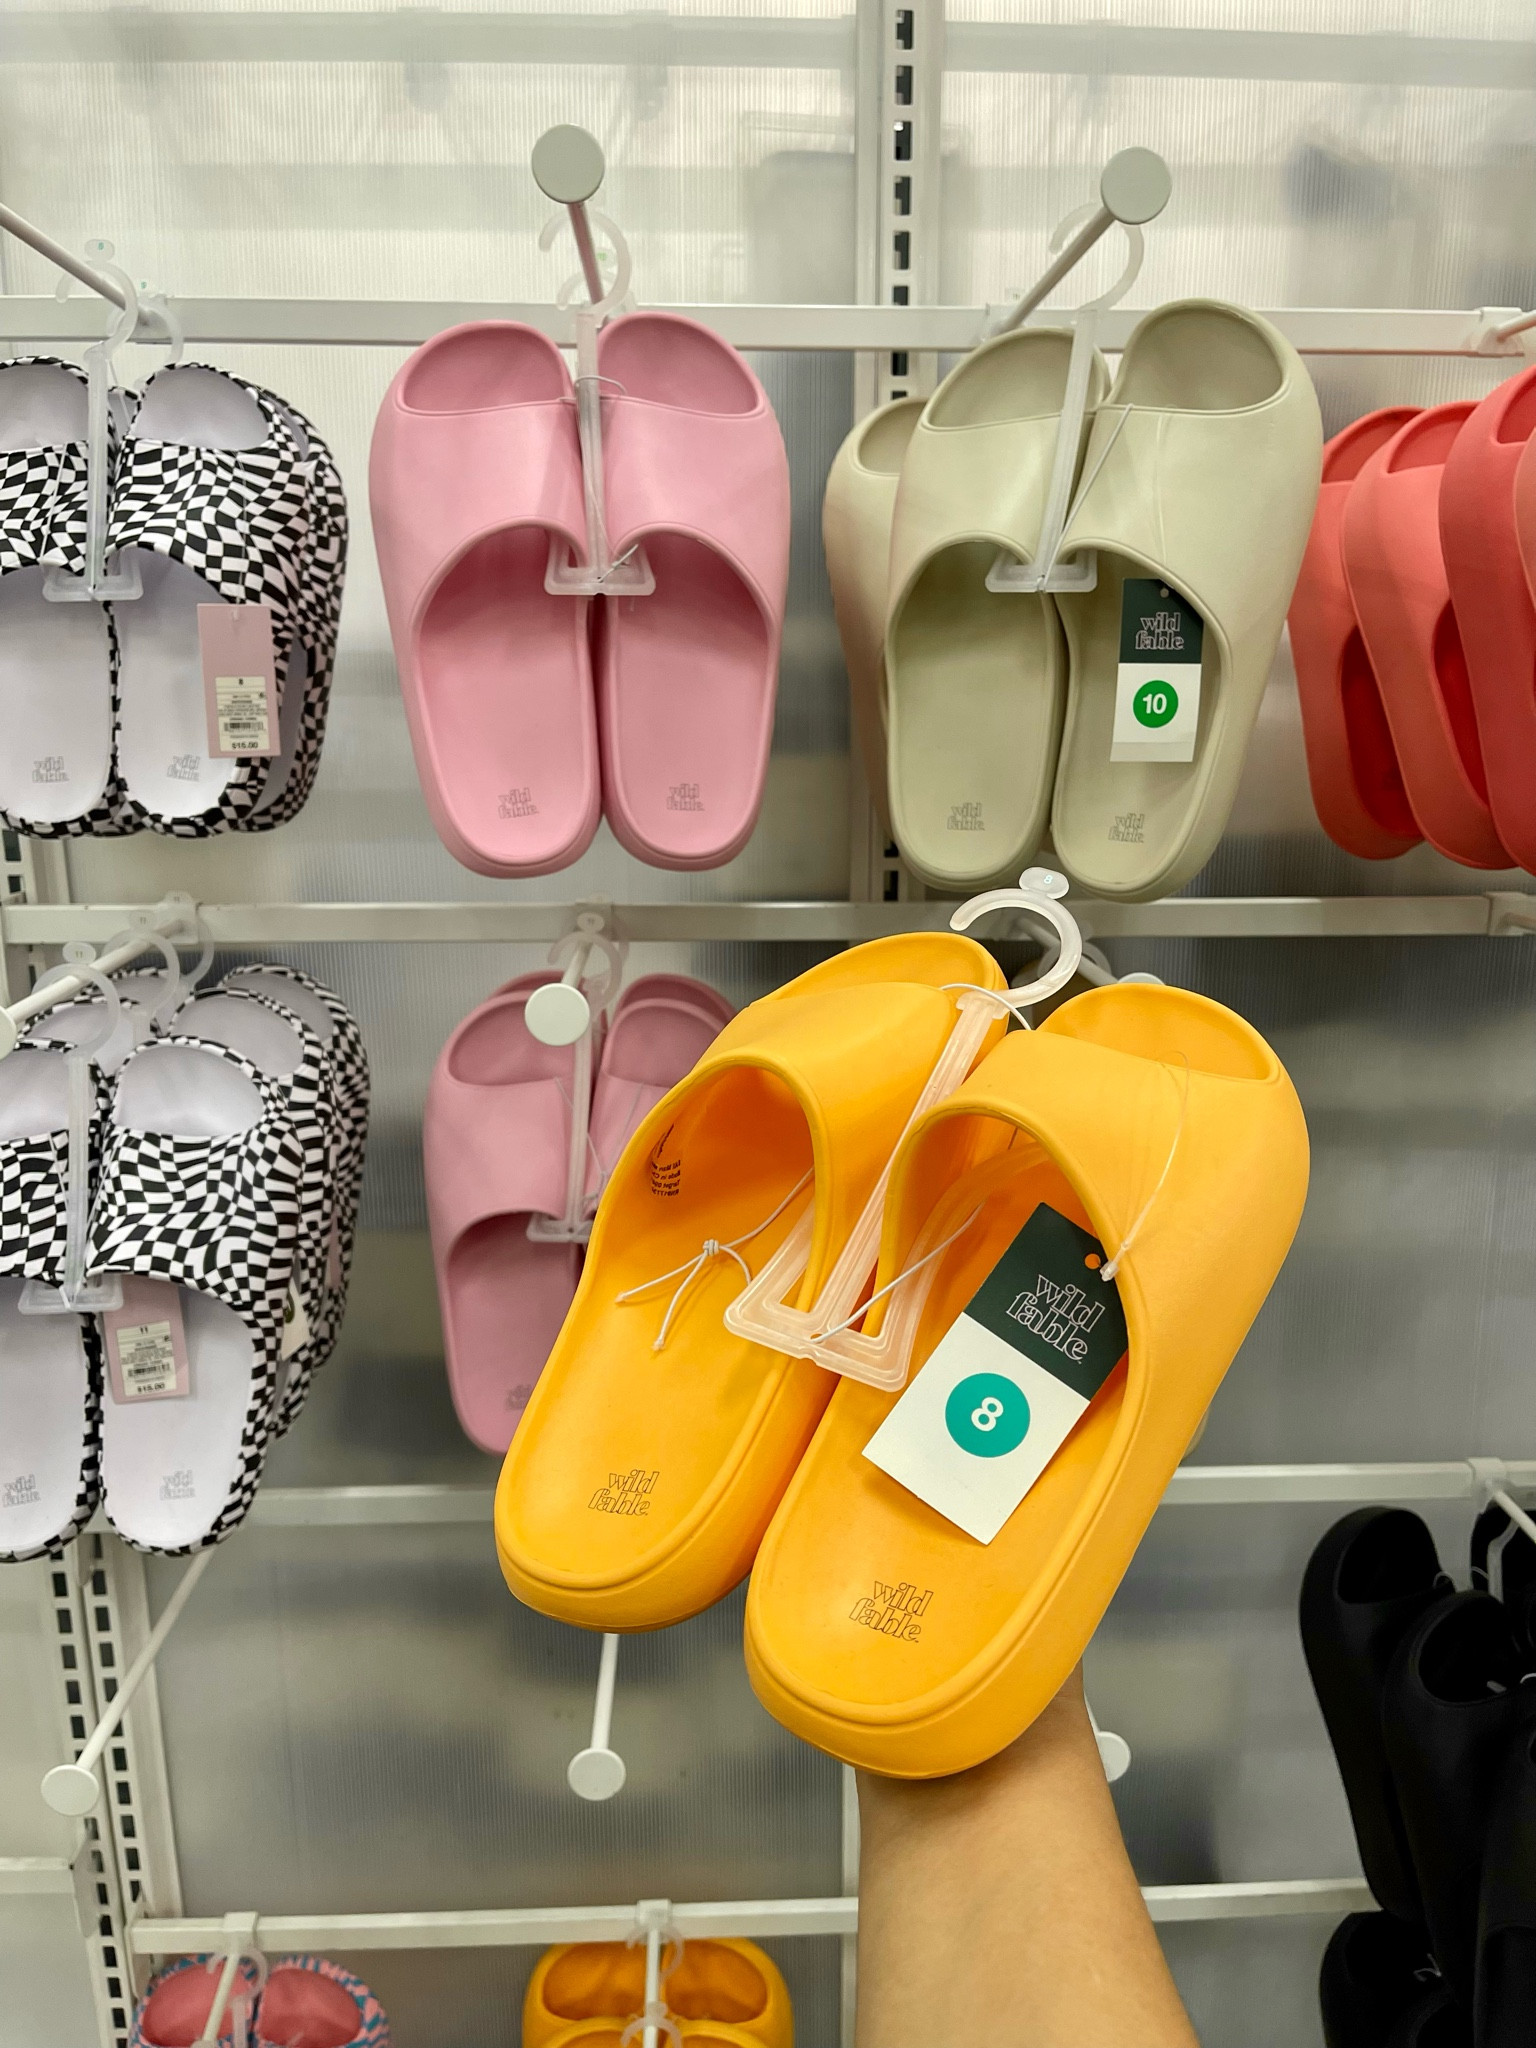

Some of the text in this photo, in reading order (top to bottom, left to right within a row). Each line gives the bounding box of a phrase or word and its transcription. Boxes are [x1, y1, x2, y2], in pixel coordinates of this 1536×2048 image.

[1140, 612, 1181, 632] wild
[1135, 630, 1184, 650] fable
[1142, 693, 1168, 715] 10
[498, 787, 532, 805] wild
[669, 783, 700, 799] wild
[950, 802, 983, 818] wild
[1115, 812, 1145, 829] wild
[1043, 874, 1053, 884] 8
[1036, 1274, 1106, 1333] wild
[1006, 1292, 1088, 1360] fable
[971, 1396, 1004, 1432] 8
[609, 1469, 660, 1494] wild
[588, 1488, 650, 1516] fable
[874, 1580, 934, 1616] wild
[849, 1598, 921, 1642] fable
